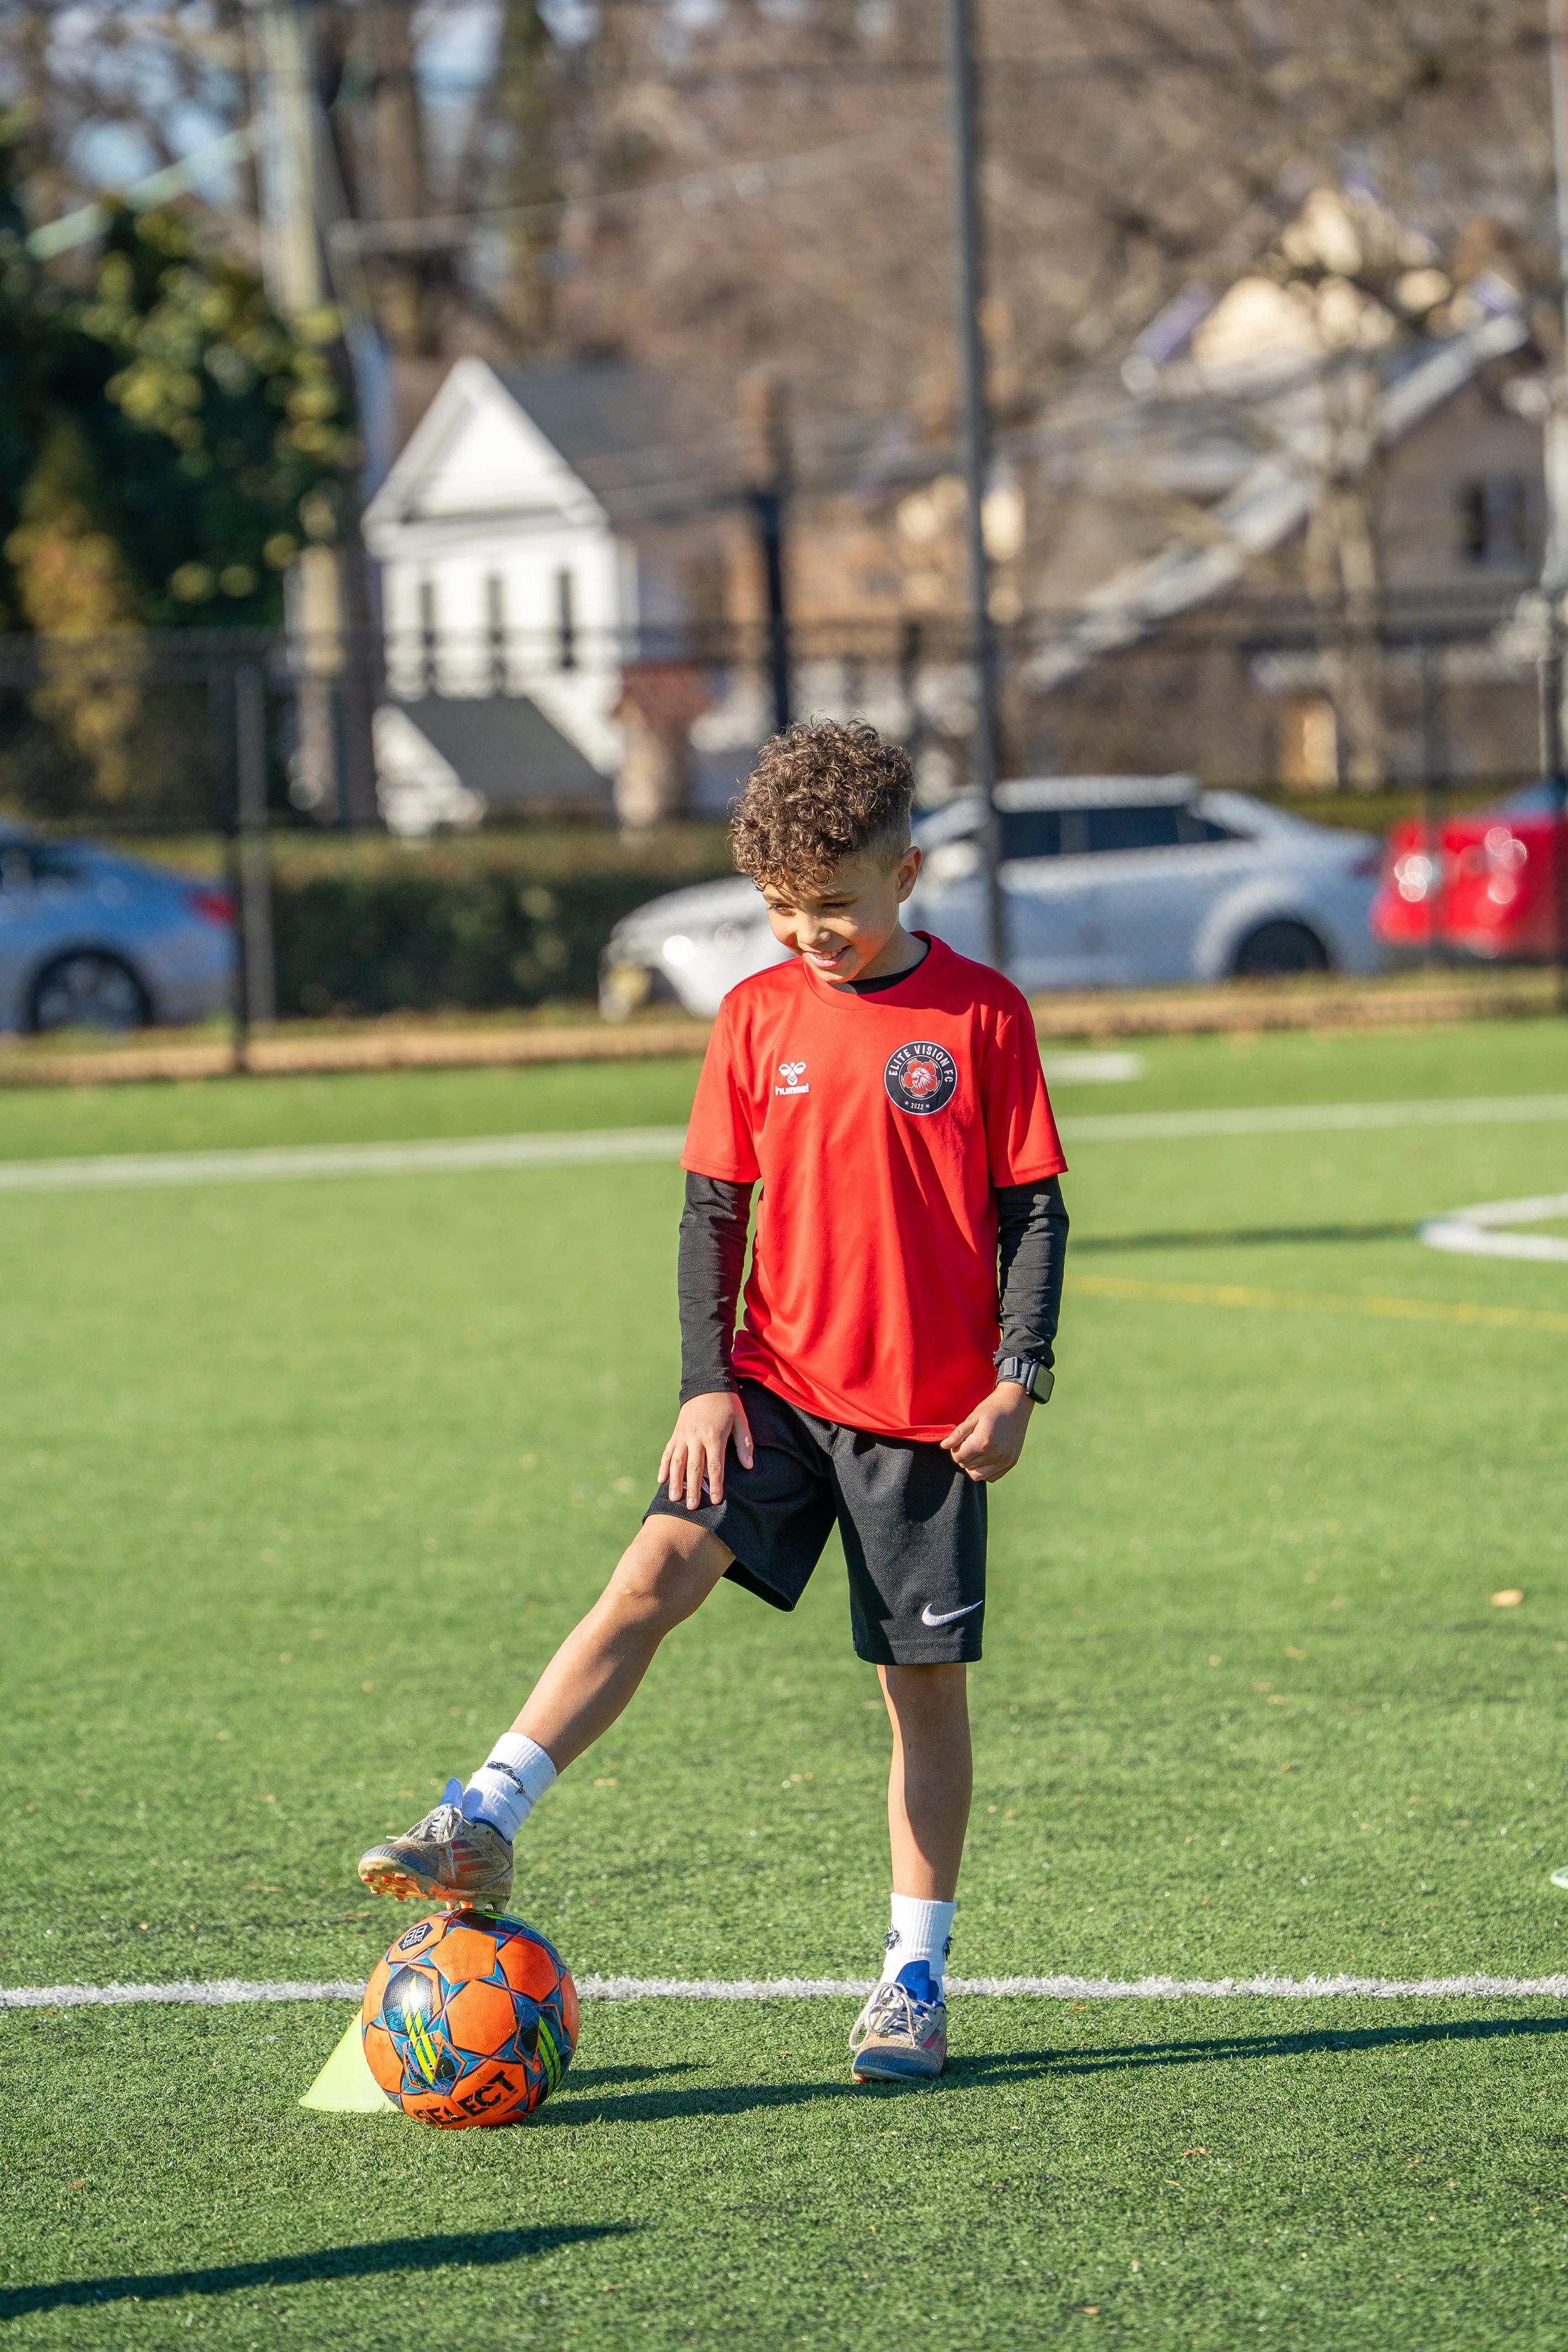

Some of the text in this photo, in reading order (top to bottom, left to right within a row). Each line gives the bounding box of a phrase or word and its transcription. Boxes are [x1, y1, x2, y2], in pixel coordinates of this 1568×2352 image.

[888, 1044, 954, 1083] ELITE VISION FC
[412, 2070, 516, 2126] SELECT
